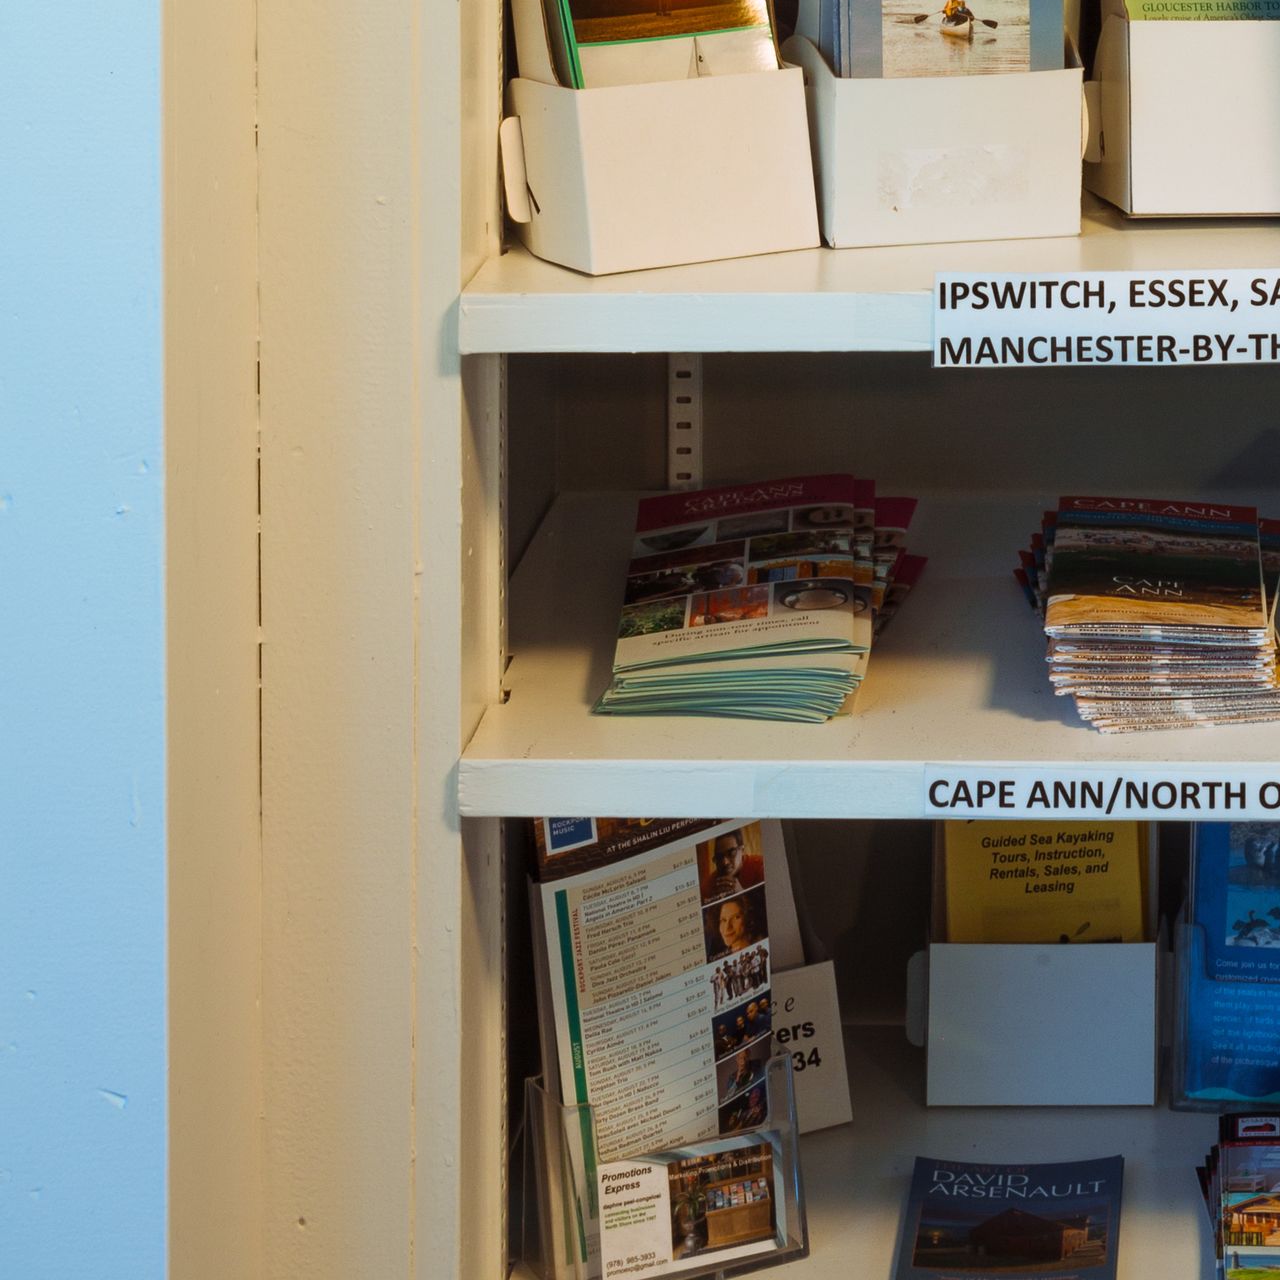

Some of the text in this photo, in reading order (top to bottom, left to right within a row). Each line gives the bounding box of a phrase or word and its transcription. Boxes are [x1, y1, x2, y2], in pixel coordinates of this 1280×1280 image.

[939, 280, 1116, 313] IPSWITCH,
[1129, 278, 1239, 312] ESSEX,
[928, 780, 1016, 808] CAPE
[1026, 777, 1246, 814] ANN/NORTH
[981, 831, 1114, 849] Guided Sea Kayaking
[991, 847, 1106, 864] Tours, Instruction,
[989, 862, 1108, 880] Rentals, Sales, and
[1025, 880, 1074, 896] Leasing
[933, 1172, 1029, 1185] DAVID
[929, 1180, 1106, 1199] ARSENAULT
